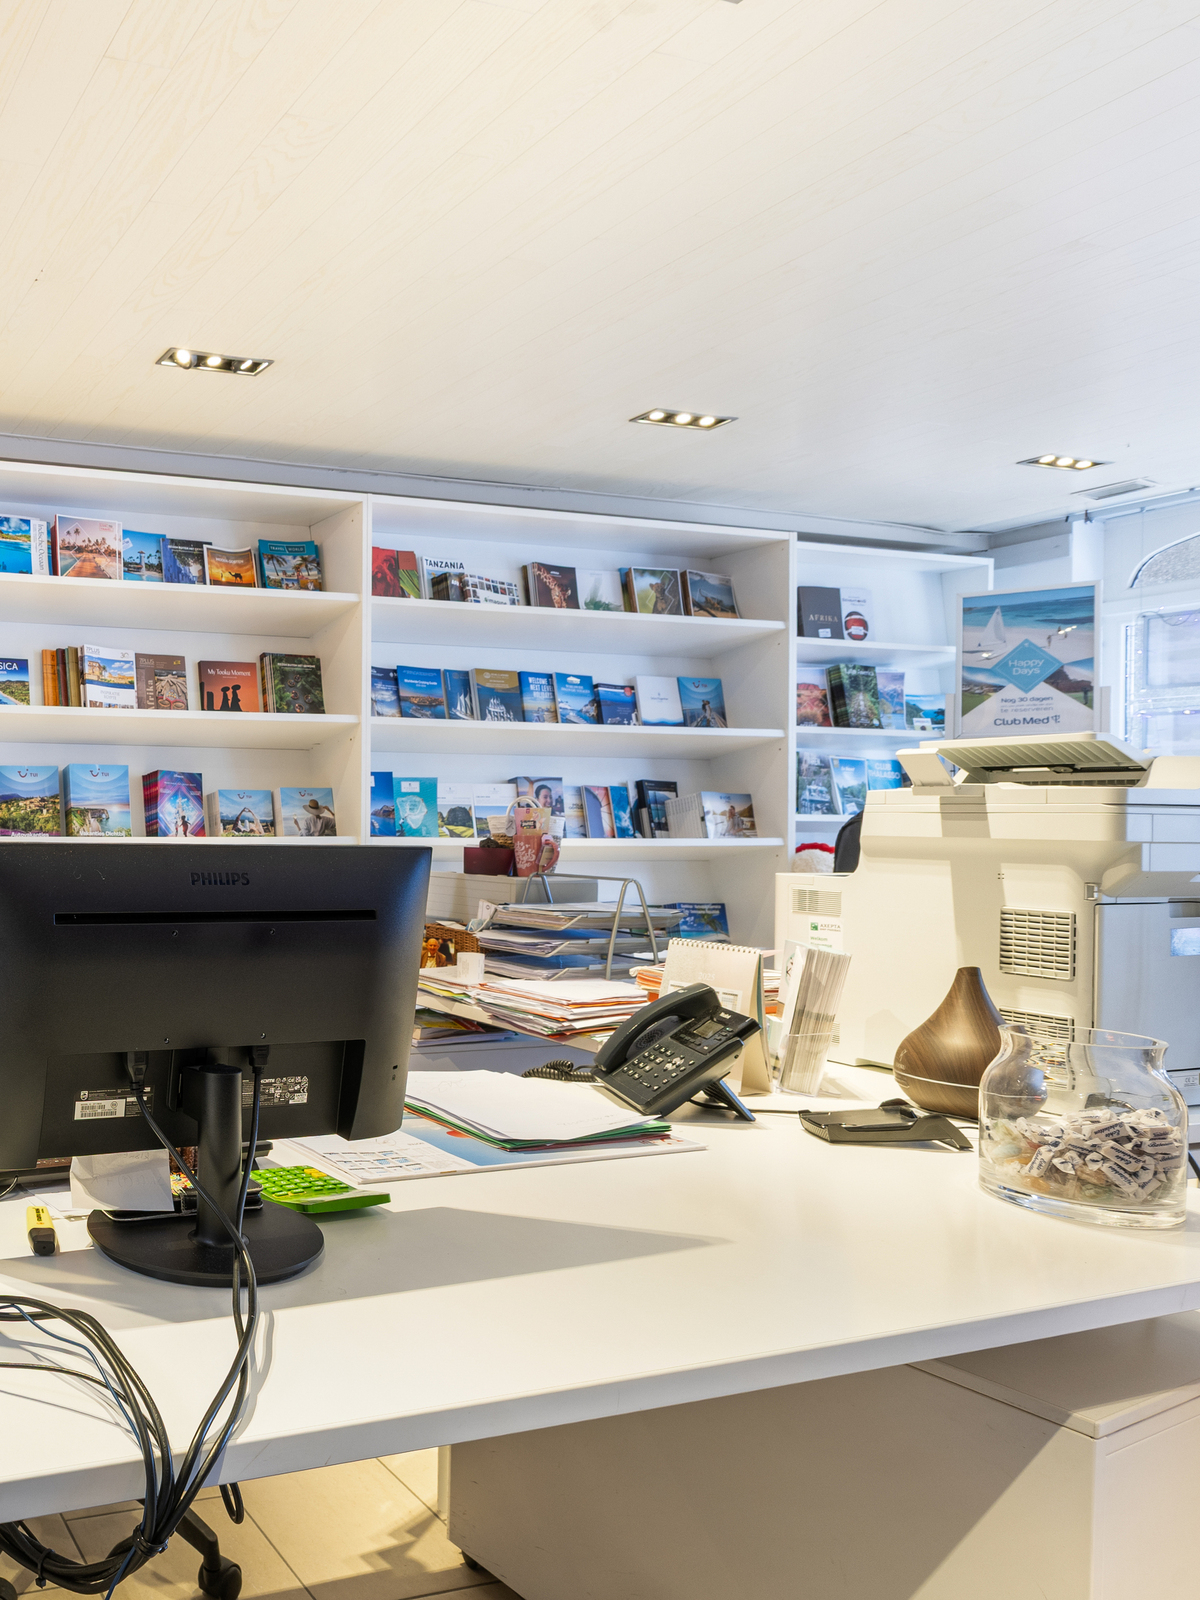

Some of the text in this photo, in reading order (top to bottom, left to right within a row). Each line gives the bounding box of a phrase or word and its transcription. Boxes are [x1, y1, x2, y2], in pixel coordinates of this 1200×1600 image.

[424, 558, 465, 570] TANZANIA
[808, 614, 838, 622] AFRIKA
[1008, 659, 1045, 668] Happy
[207, 668, 216, 676] My
[231, 669, 251, 677] Moment
[1012, 667, 1040, 676] Days
[528, 676, 548, 685] WELCOME
[994, 716, 1050, 726] Club Med
[868, 769, 901, 779] THALASSO
[190, 872, 250, 886] PHILIPS
[1105, 1129, 1120, 1138] Echte
